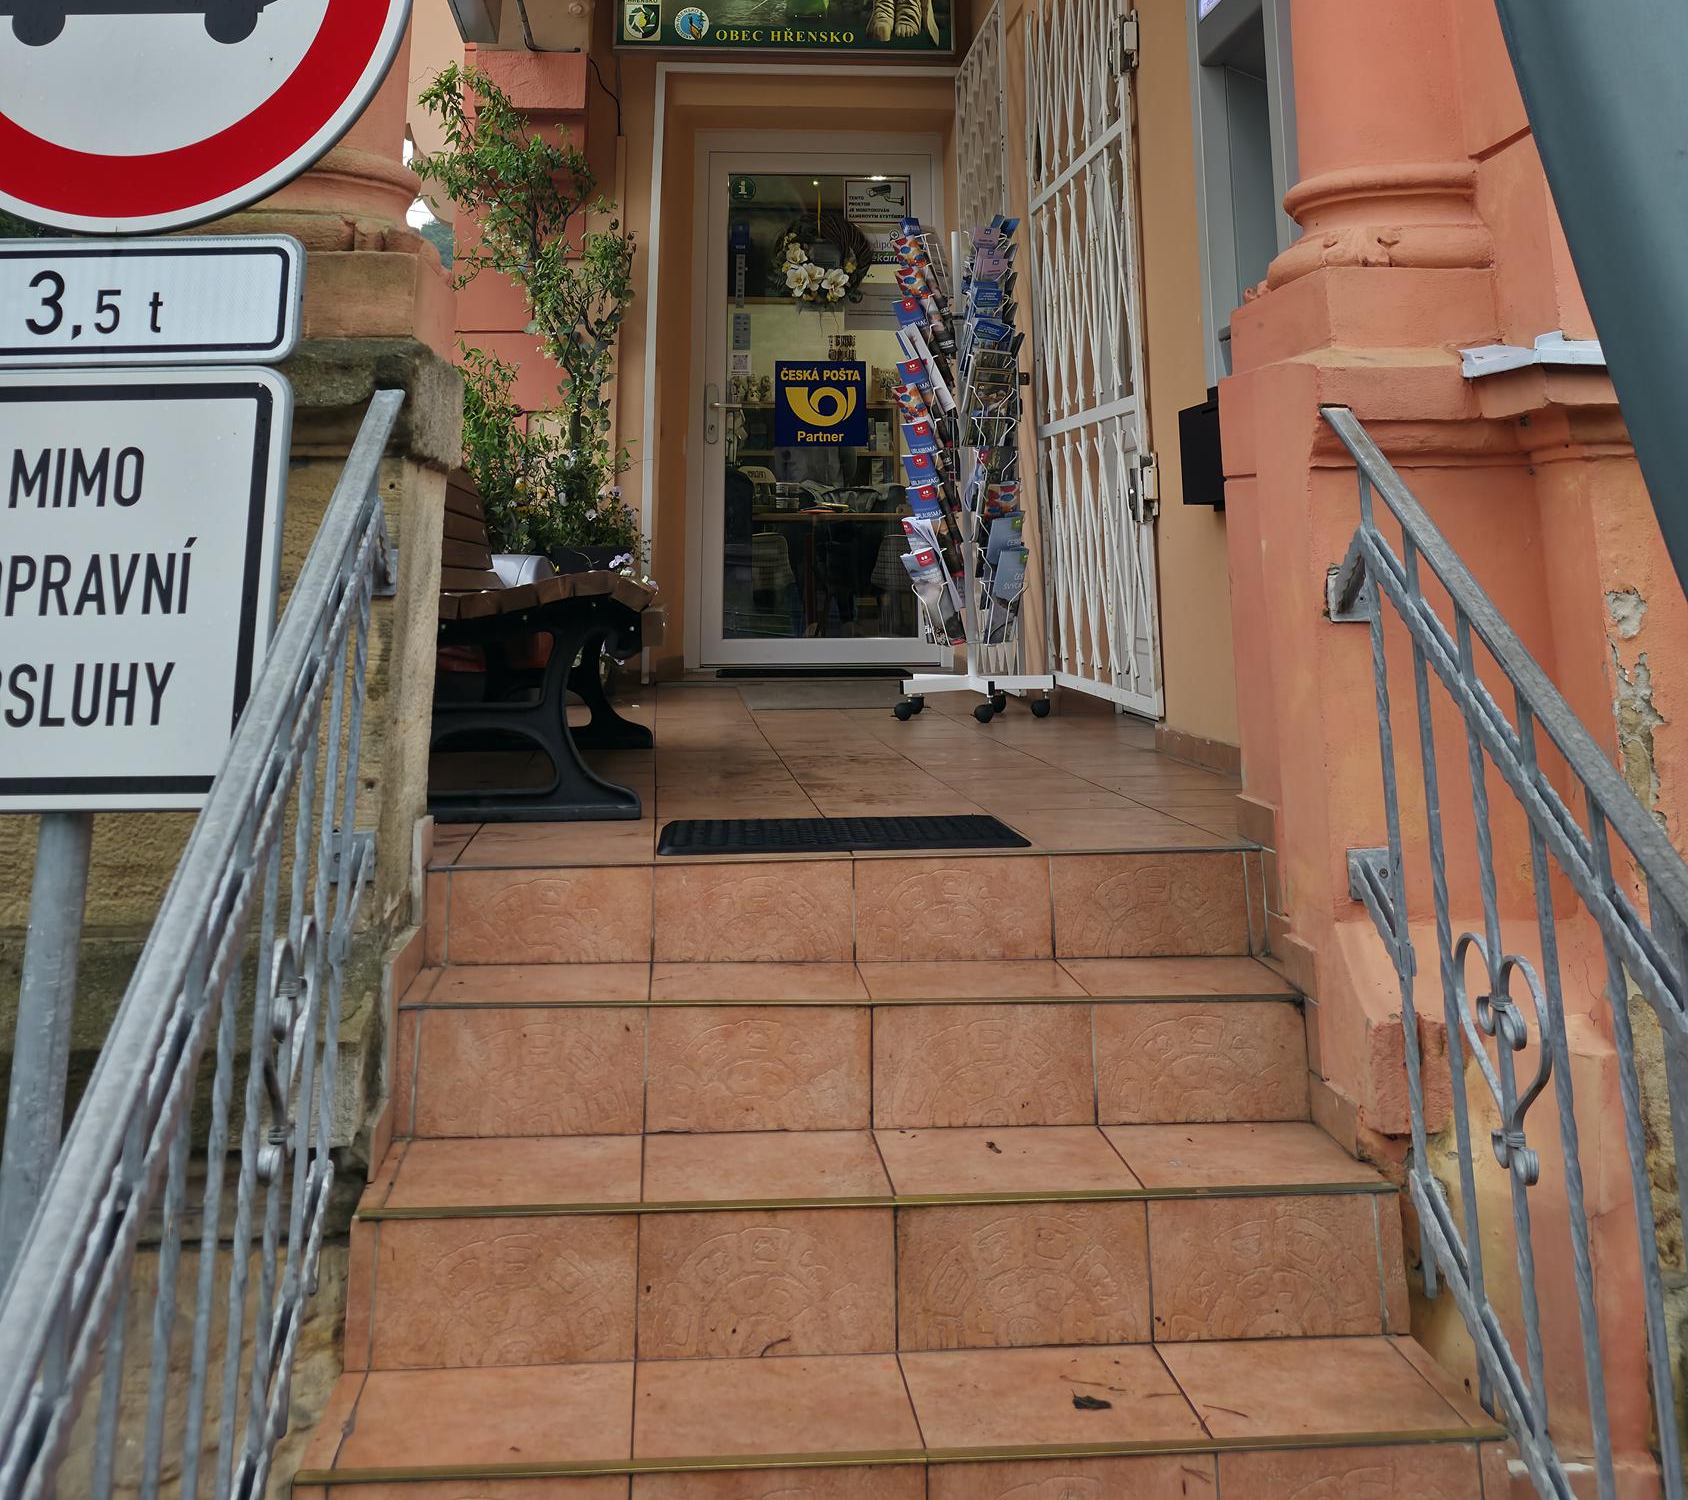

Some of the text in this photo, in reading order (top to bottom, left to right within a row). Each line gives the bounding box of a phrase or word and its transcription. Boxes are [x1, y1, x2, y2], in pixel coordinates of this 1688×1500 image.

[715, 28, 854, 43] OBEC HŘENSKO
[25, 270, 164, 341] 3,5 t
[780, 367, 861, 381] ČESKÁ POŠTA
[797, 431, 844, 442] Partner
[8, 446, 145, 509] MIMO
[0, 537, 197, 617] PRAVNÍ
[0, 661, 176, 728] SLUHY
